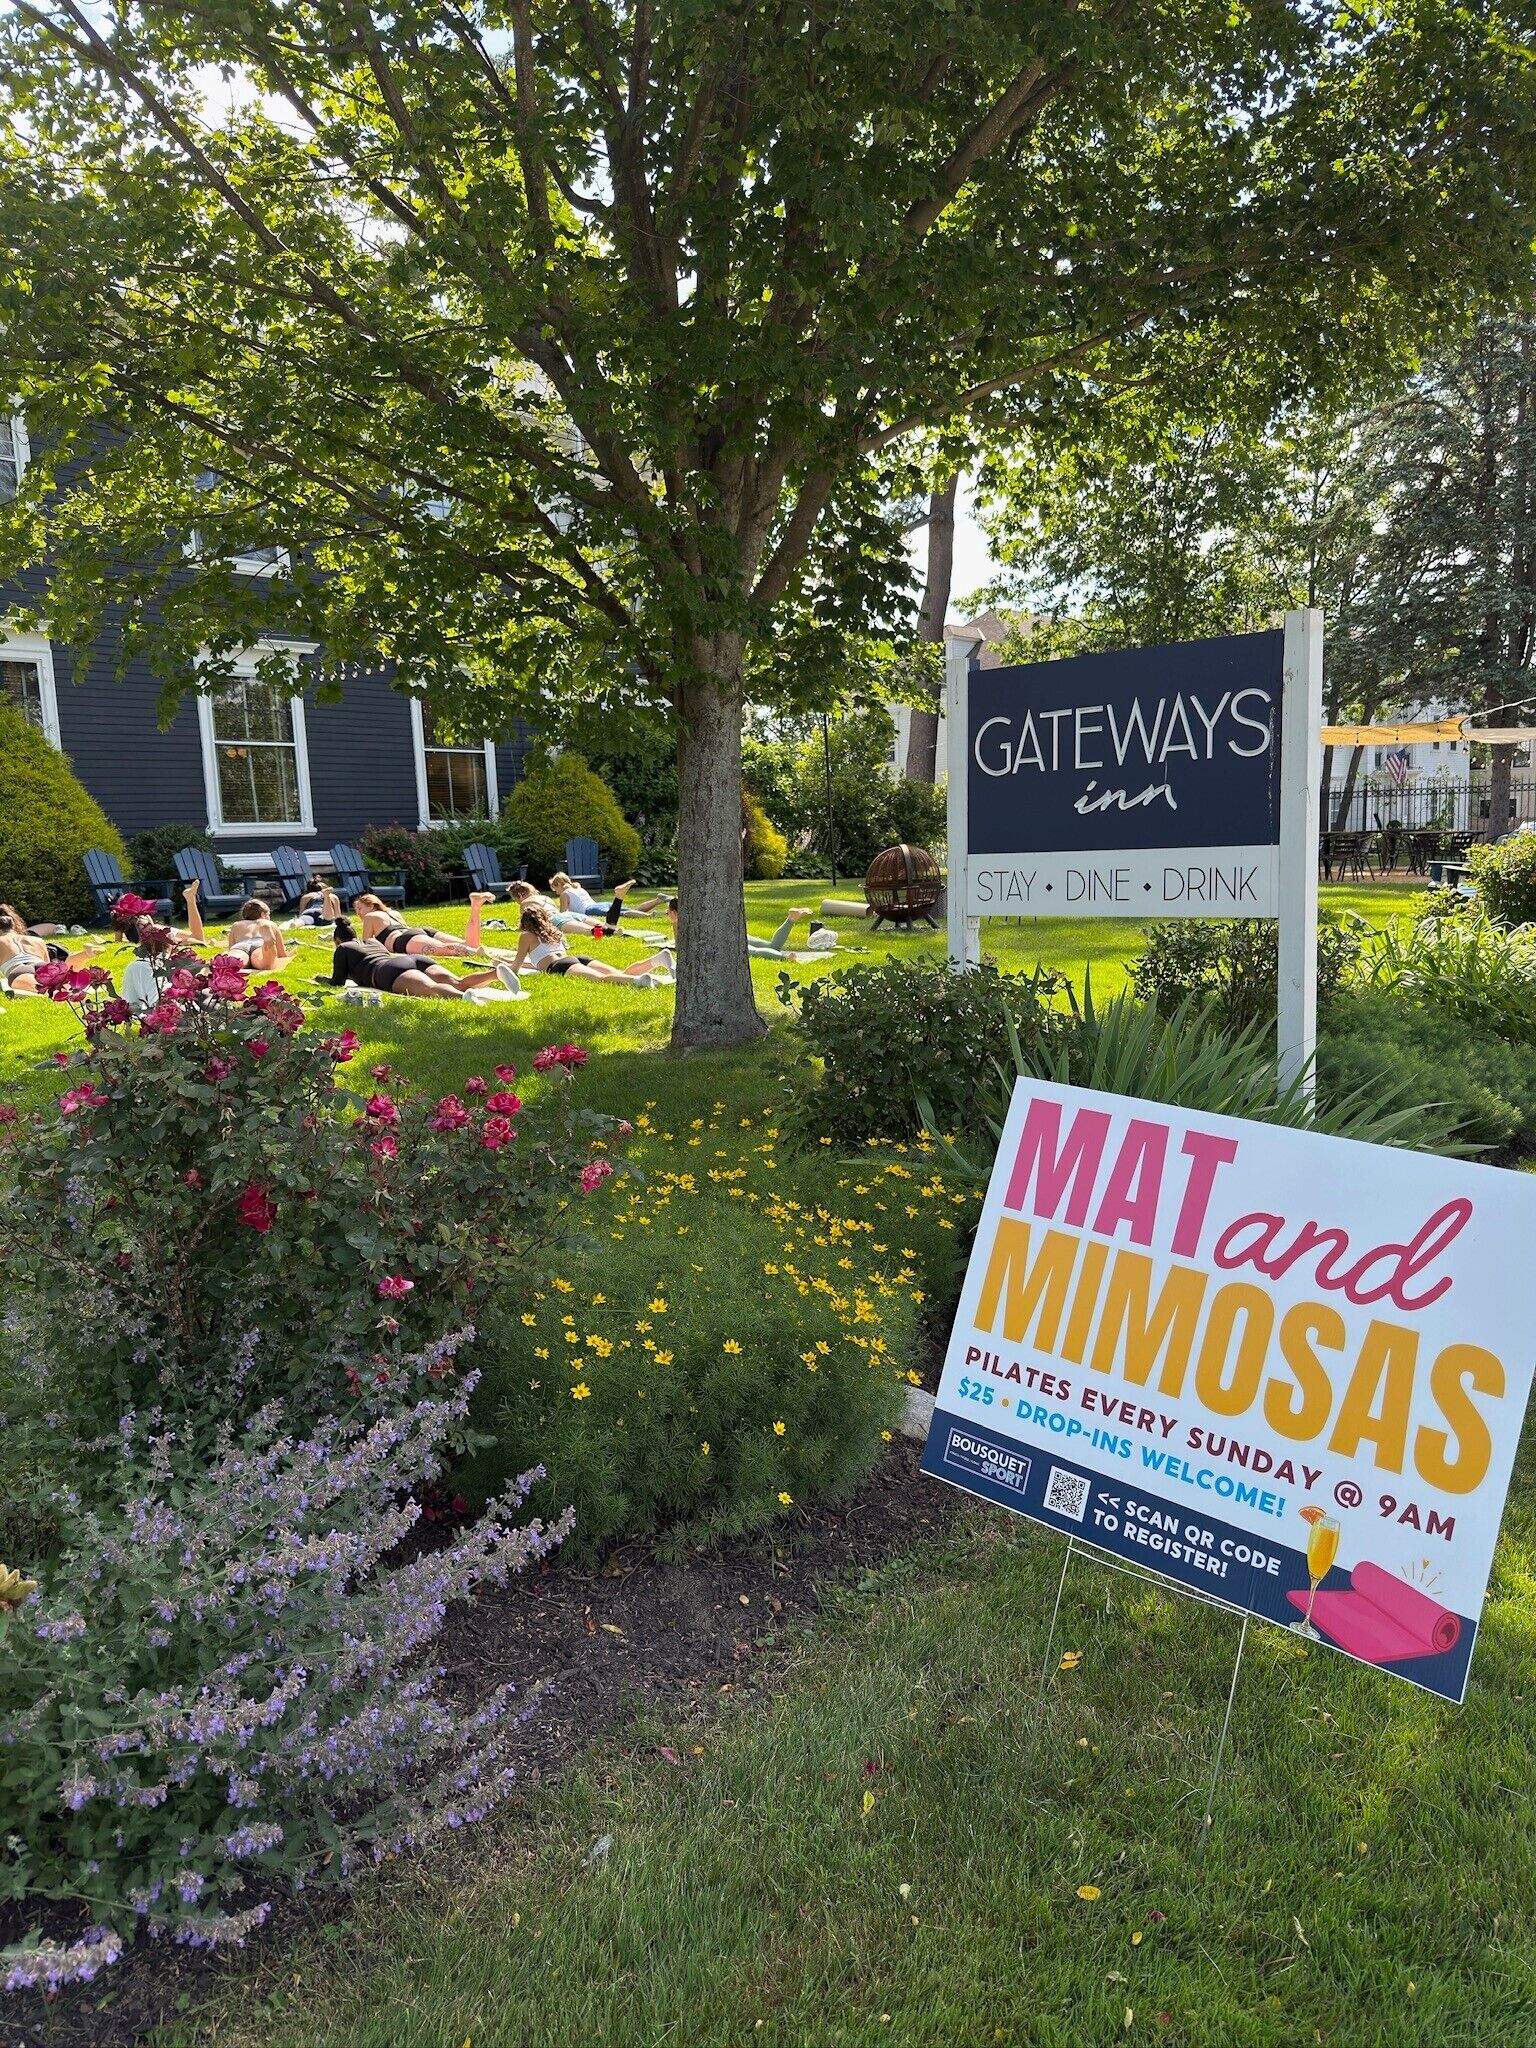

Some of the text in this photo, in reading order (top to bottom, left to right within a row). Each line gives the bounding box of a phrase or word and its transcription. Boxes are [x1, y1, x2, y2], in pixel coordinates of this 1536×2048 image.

[974, 687, 1272, 777] GATEWAYS
[1073, 779, 1178, 815] inn
[976, 866, 1259, 902] STAY DINE DRINK
[1003, 1097, 1474, 1311] MAT and
[973, 1215, 1506, 1495] MIMOSAS
[951, 1434, 1027, 1474] BOUSQUET
[958, 1376, 1287, 1518] $25 DROP-INS WELCOME!
[965, 1346, 1457, 1542] PILATES EVERY SUNDAY @ 9AM
[980, 1461, 1024, 1488] SPORT
[1092, 1508, 1229, 1578] TO REGISTER!
[1125, 1500, 1179, 1536] SCAN
[1184, 1523, 1214, 1549] QR
[1220, 1538, 1282, 1576] CODE
